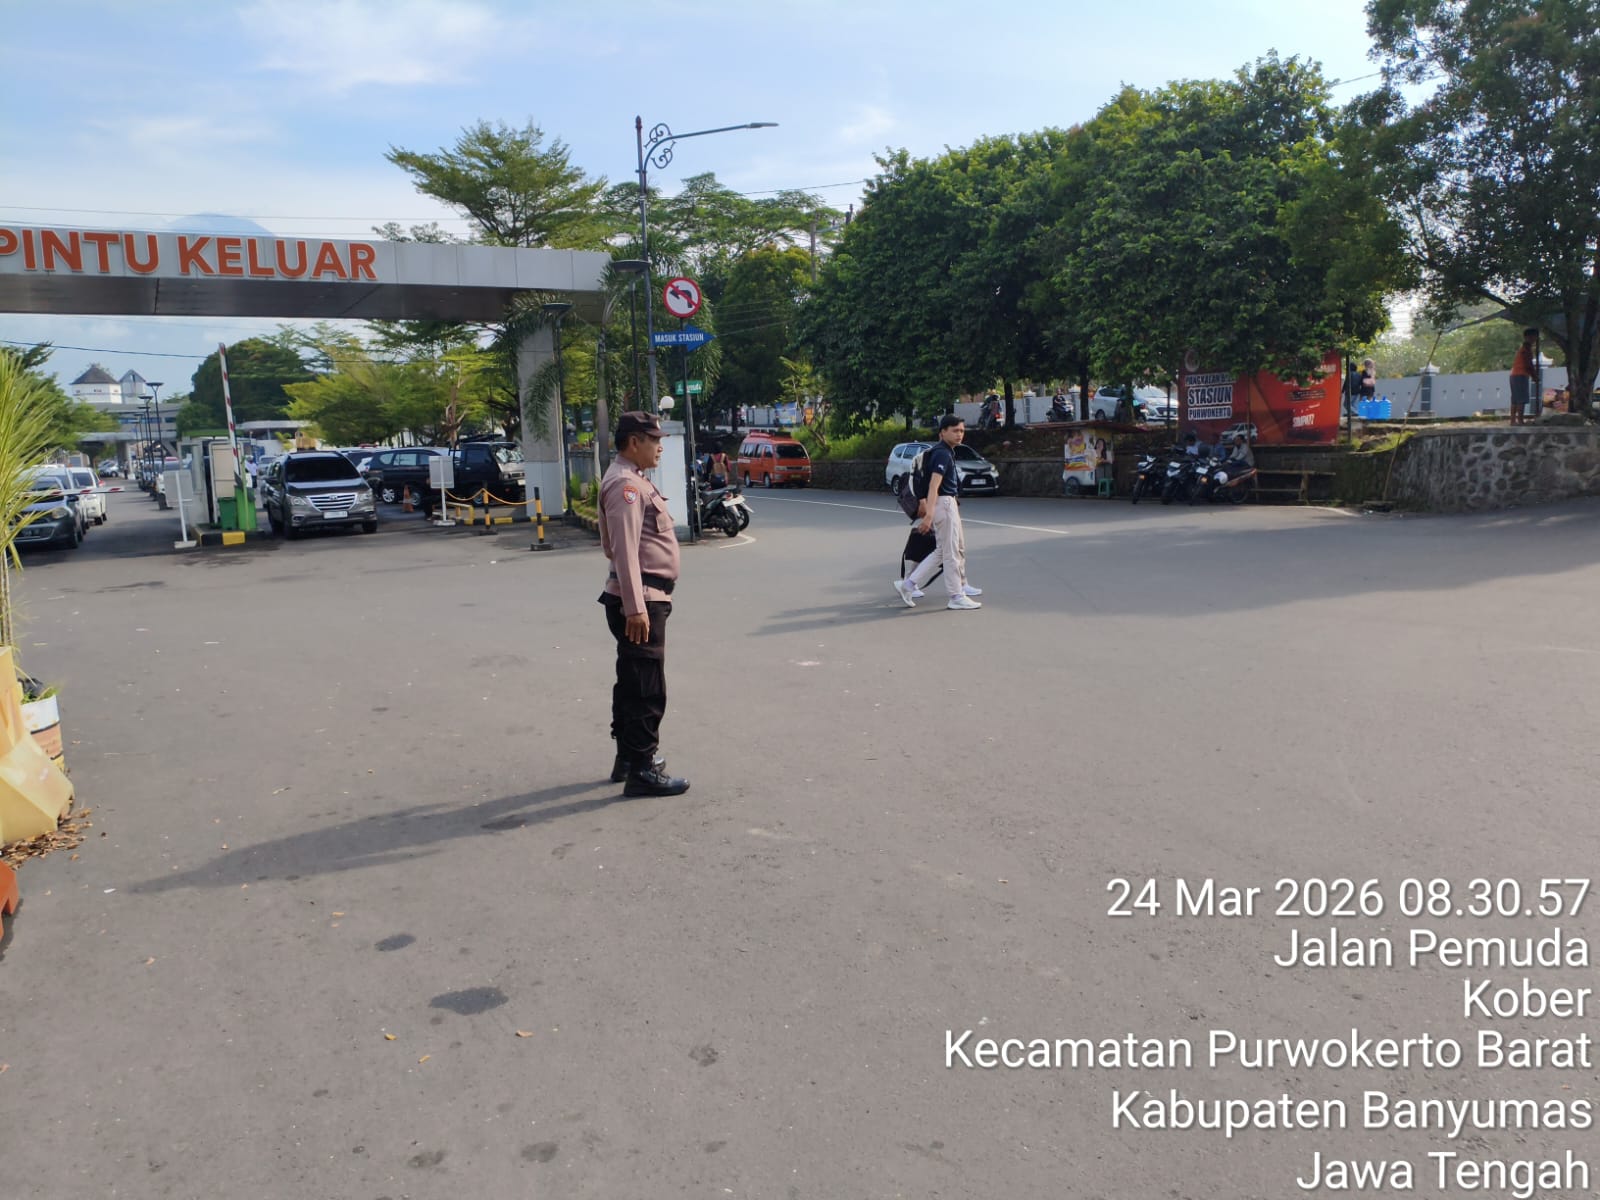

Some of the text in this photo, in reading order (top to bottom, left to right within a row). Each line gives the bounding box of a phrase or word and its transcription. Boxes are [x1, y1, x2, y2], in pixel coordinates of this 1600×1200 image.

[0, 226, 378, 281] PINTU KELUAR
[654, 333, 704, 343] MASUK STASIUN
[1188, 386, 1232, 406] STASIUN
[1188, 406, 1232, 420] PURWOKERTO
